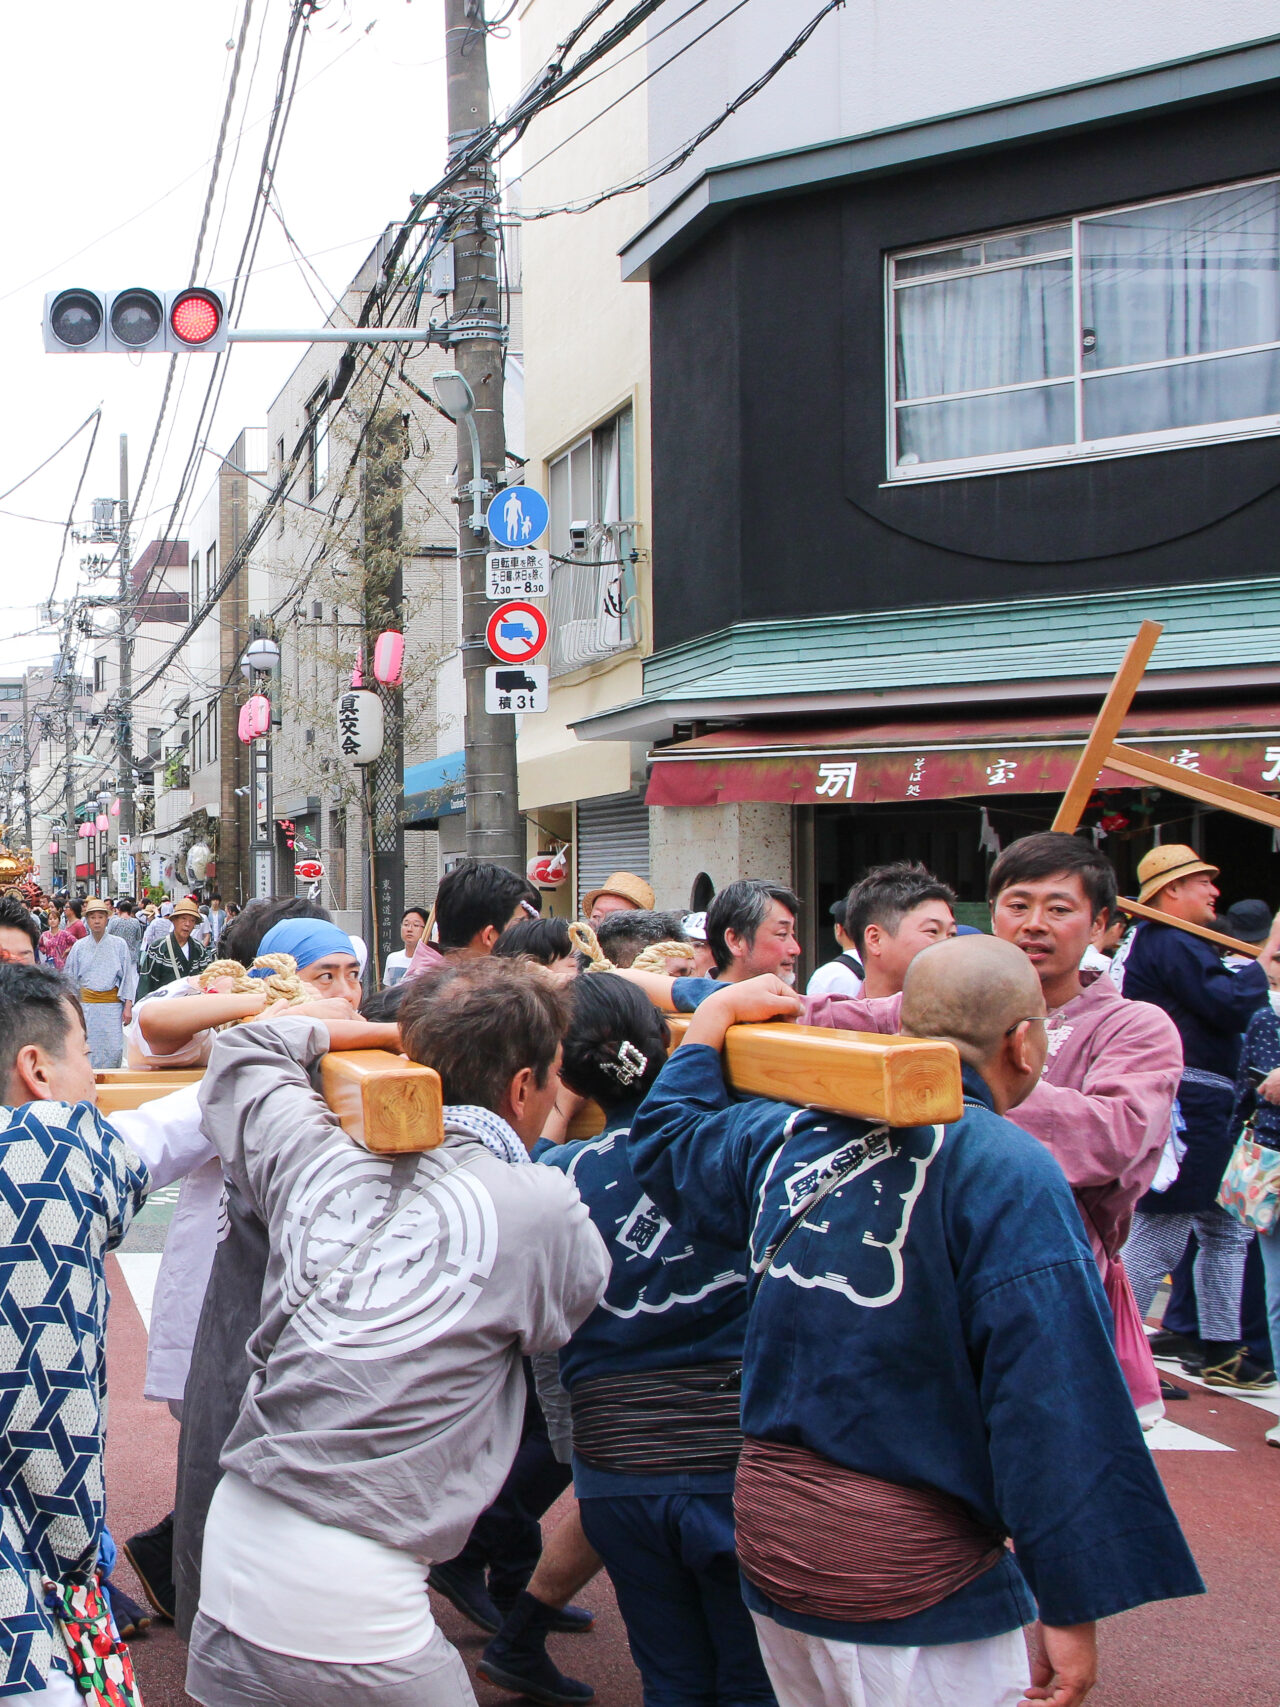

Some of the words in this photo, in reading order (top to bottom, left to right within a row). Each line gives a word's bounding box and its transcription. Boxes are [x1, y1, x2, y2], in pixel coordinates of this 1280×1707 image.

[491, 555, 544, 569] 自転車を除く
[339, 693, 361, 755] 真交会
[905, 757, 926, 797] そば処
[986, 758, 1018, 786] 宝
[382, 879, 392, 953] 東海道品川宿
